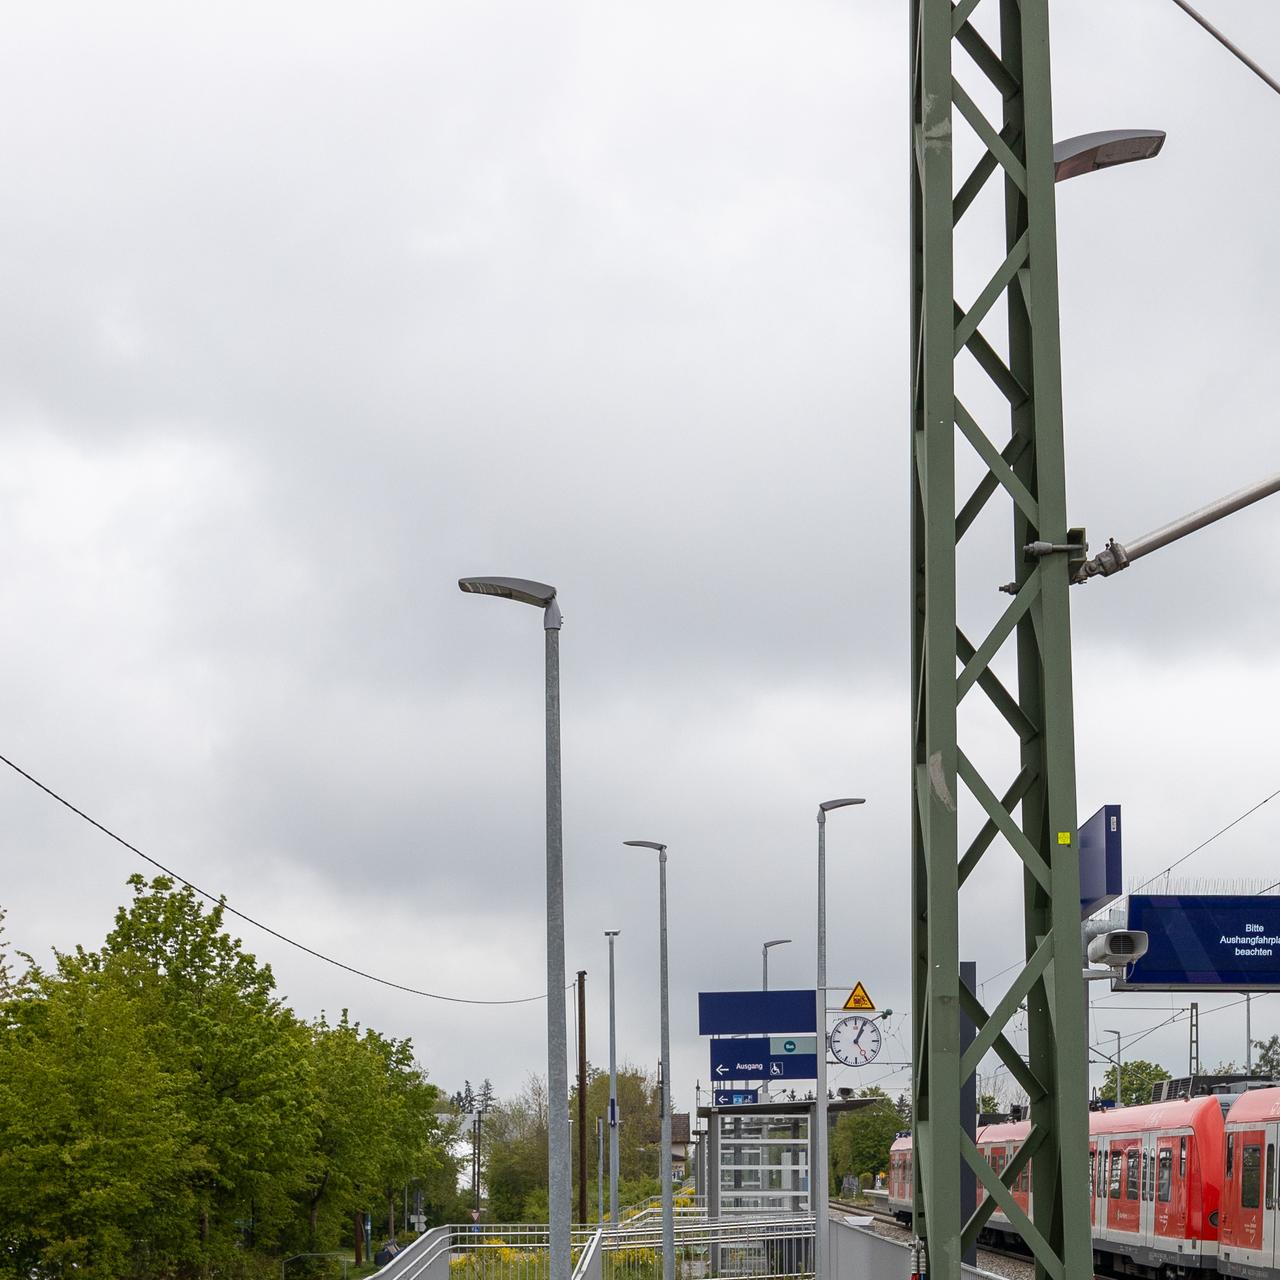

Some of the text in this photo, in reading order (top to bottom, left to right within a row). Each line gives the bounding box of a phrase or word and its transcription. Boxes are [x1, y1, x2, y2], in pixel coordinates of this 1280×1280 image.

[1245, 923, 1265, 933] Bitte
[1234, 947, 1273, 956] beachten
[735, 1062, 764, 1071] Ausgang
